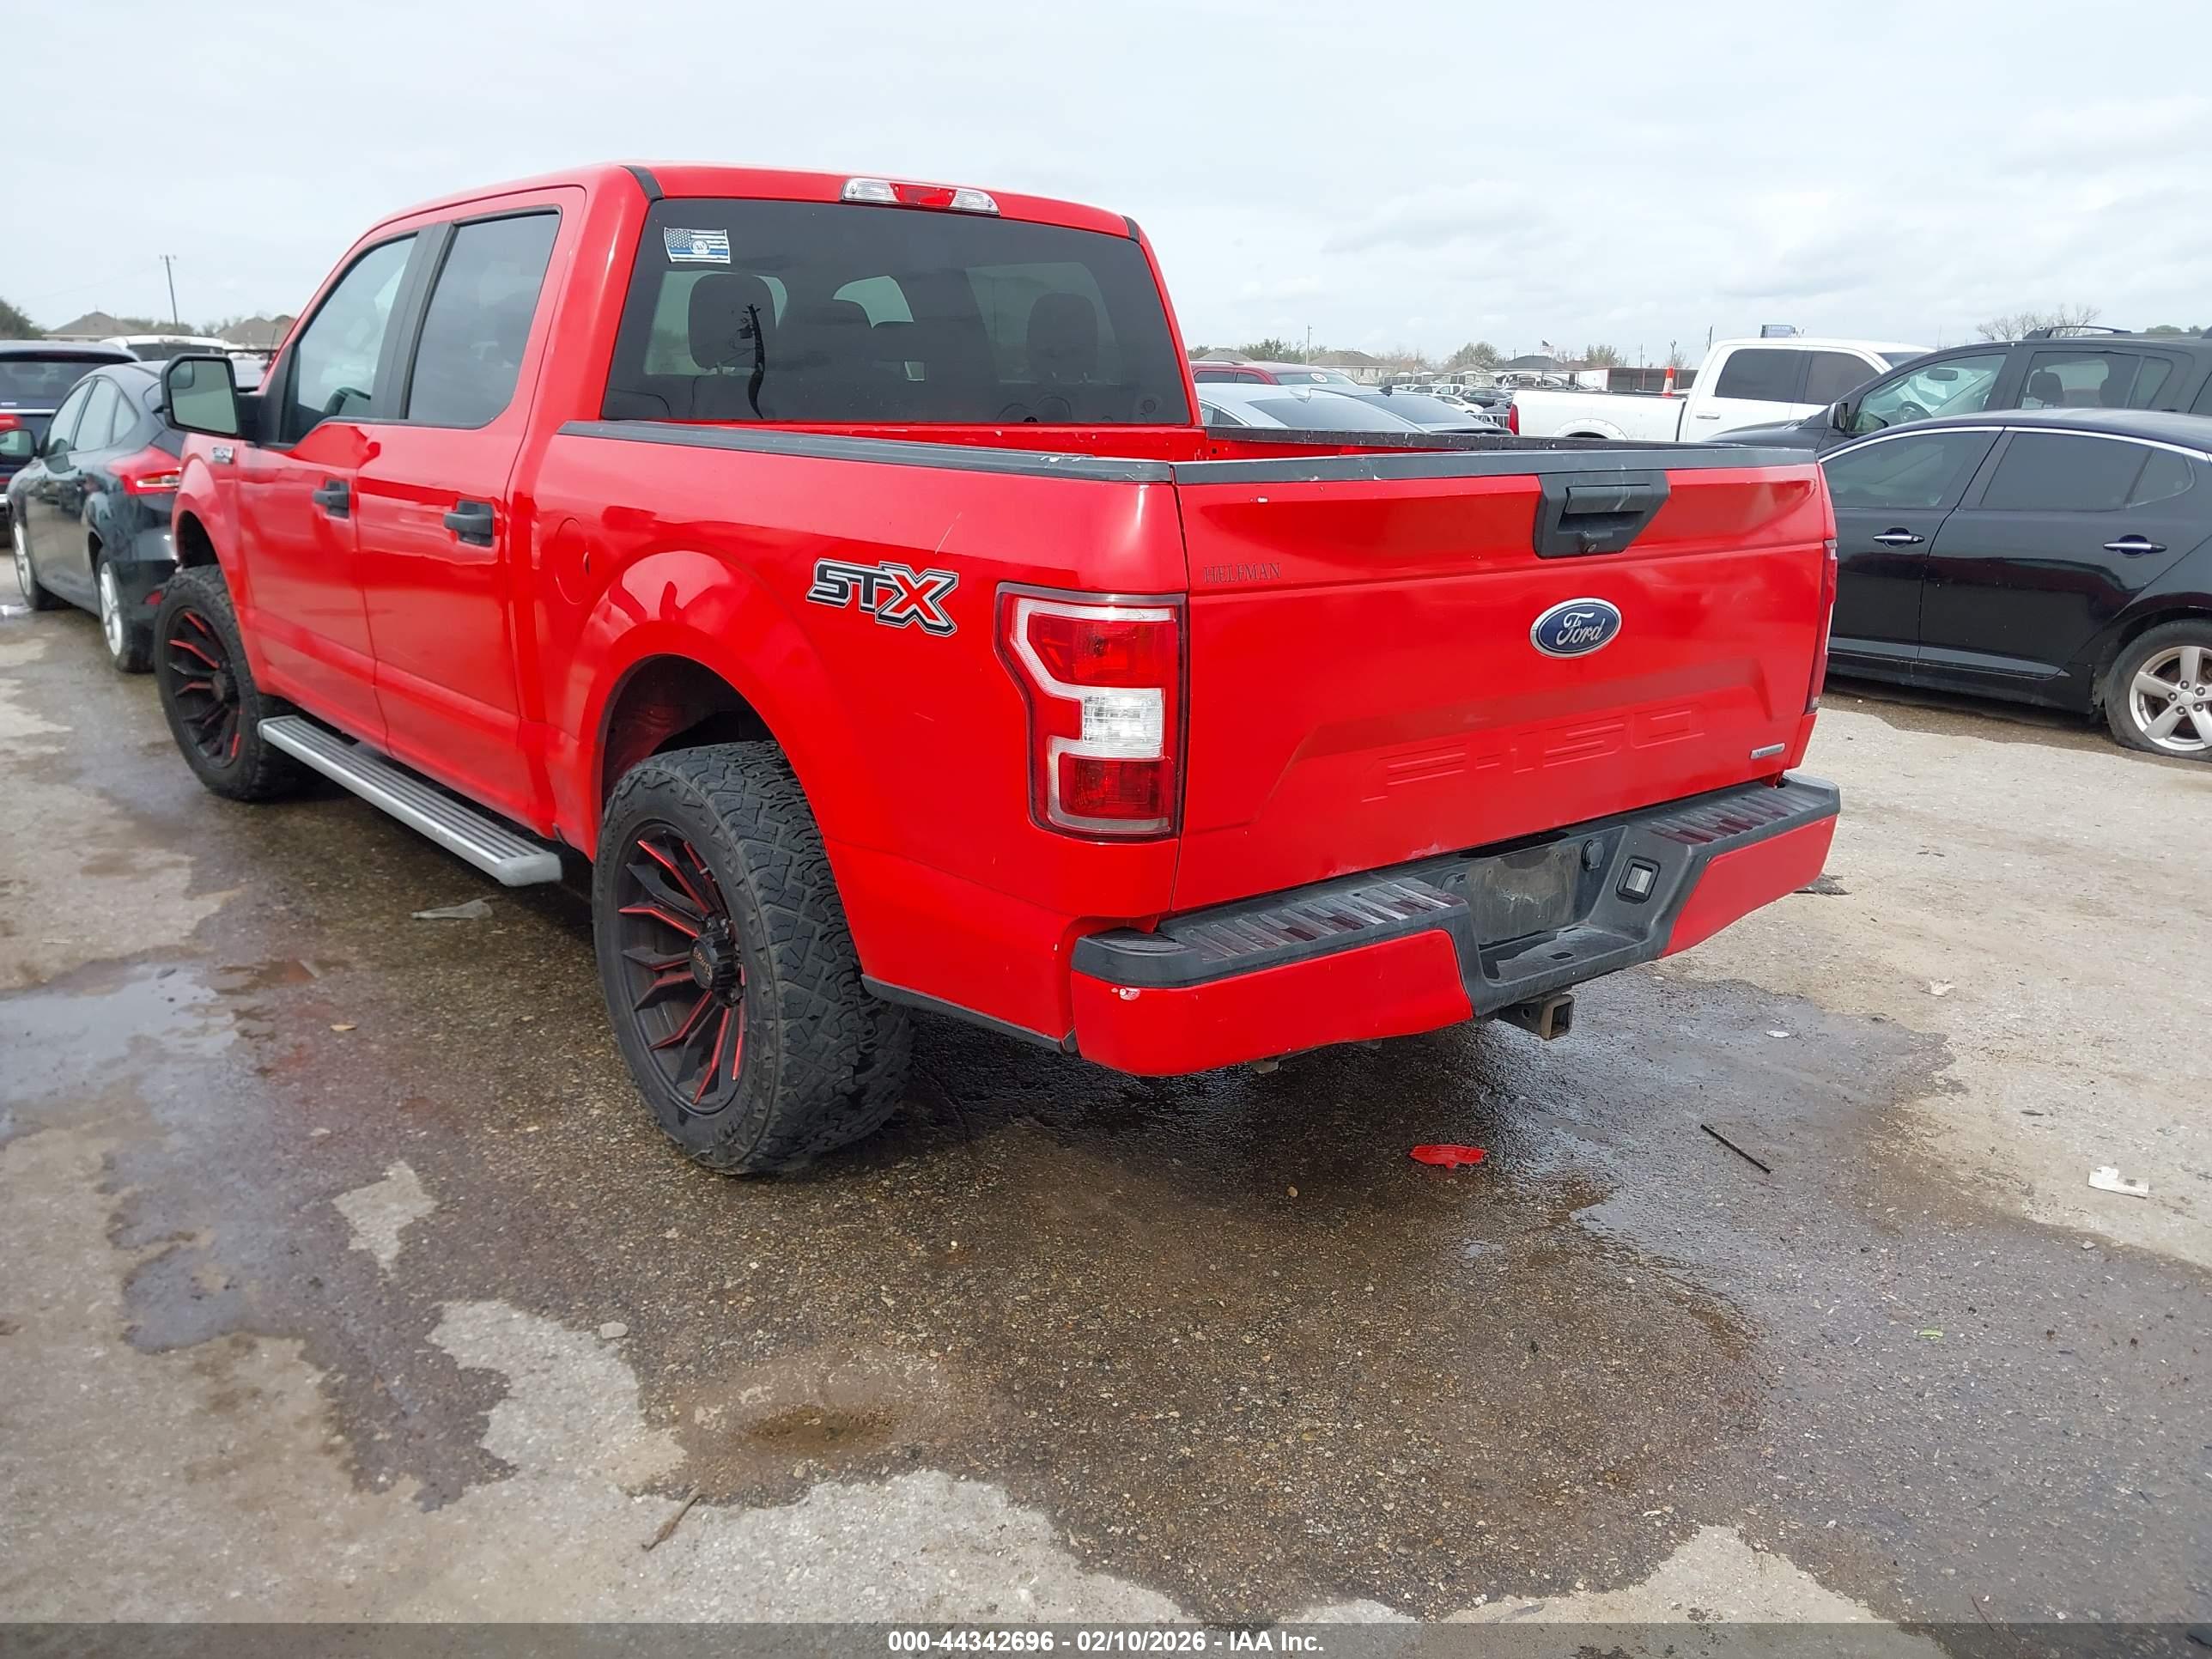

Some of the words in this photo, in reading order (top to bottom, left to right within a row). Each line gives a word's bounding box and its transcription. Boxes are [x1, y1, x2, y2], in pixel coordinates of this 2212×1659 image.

[806, 557, 959, 637] STX
[1204, 562, 1281, 583] HELFMAN
[1556, 612, 1606, 646] Ford
[1361, 702, 1707, 803] F-150
